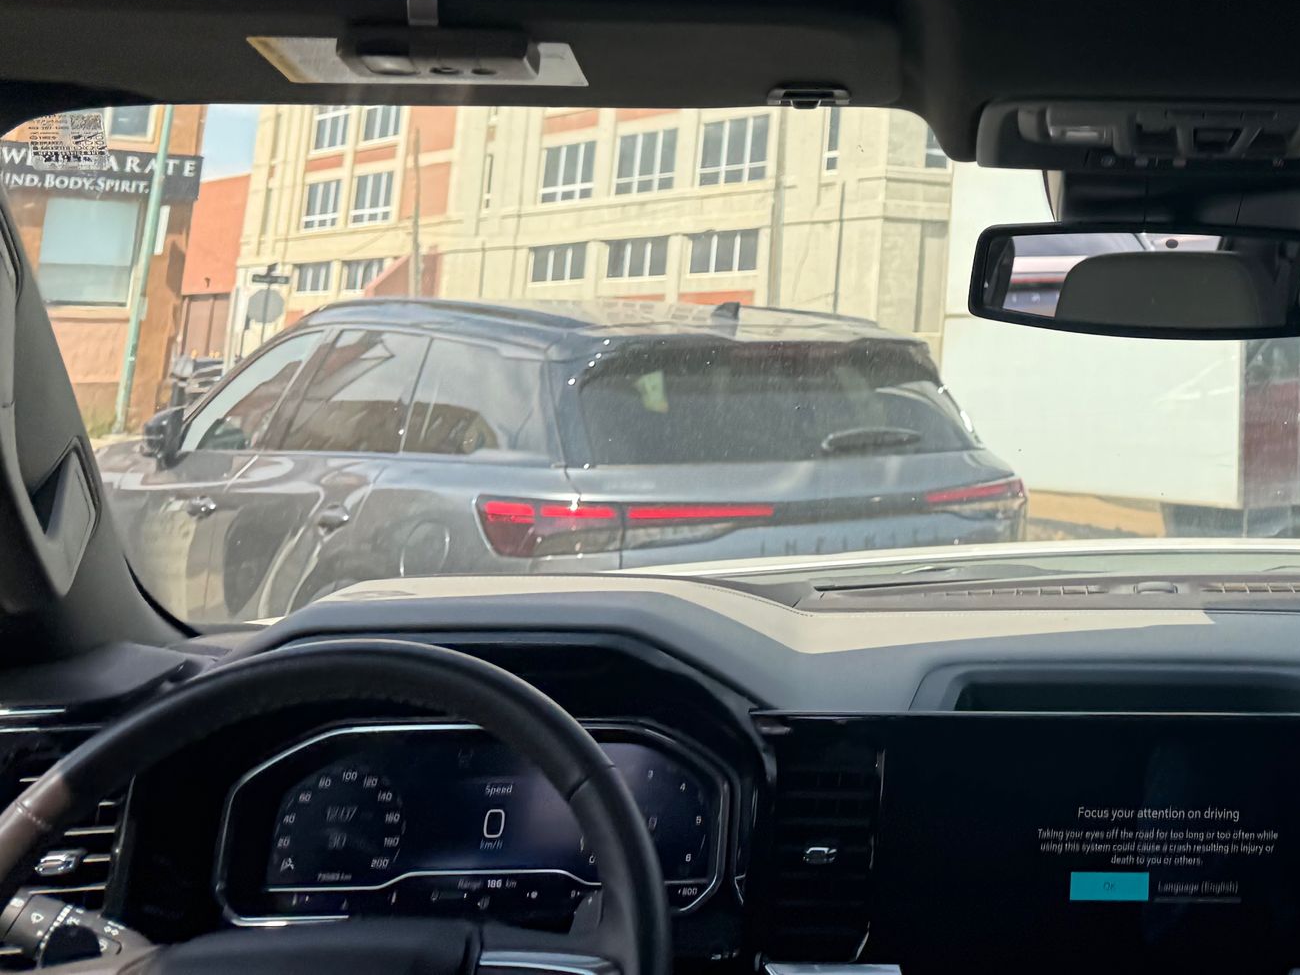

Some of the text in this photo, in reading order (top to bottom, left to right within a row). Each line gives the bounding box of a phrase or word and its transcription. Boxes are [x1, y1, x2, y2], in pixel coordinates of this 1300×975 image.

[101, 153, 198, 178] ARATE
[0, 172, 42, 188] IND.
[485, 784, 513, 797] Speed
[1077, 806, 1240, 823] Focus your attention on driving
[483, 809, 506, 838] 0
[1038, 828, 1279, 842] Taking your eyes off the road for too long or too often while
[1081, 842, 1111, 855] system
[1112, 841, 1136, 853] could
[1169, 842, 1192, 853] crash
[1192, 842, 1230, 855] resulting
[1265, 845, 1275, 854] or
[1110, 854, 1135, 866] death
[1136, 855, 1146, 865] to
[1146, 856, 1162, 868] you
[1163, 856, 1173, 866] or
